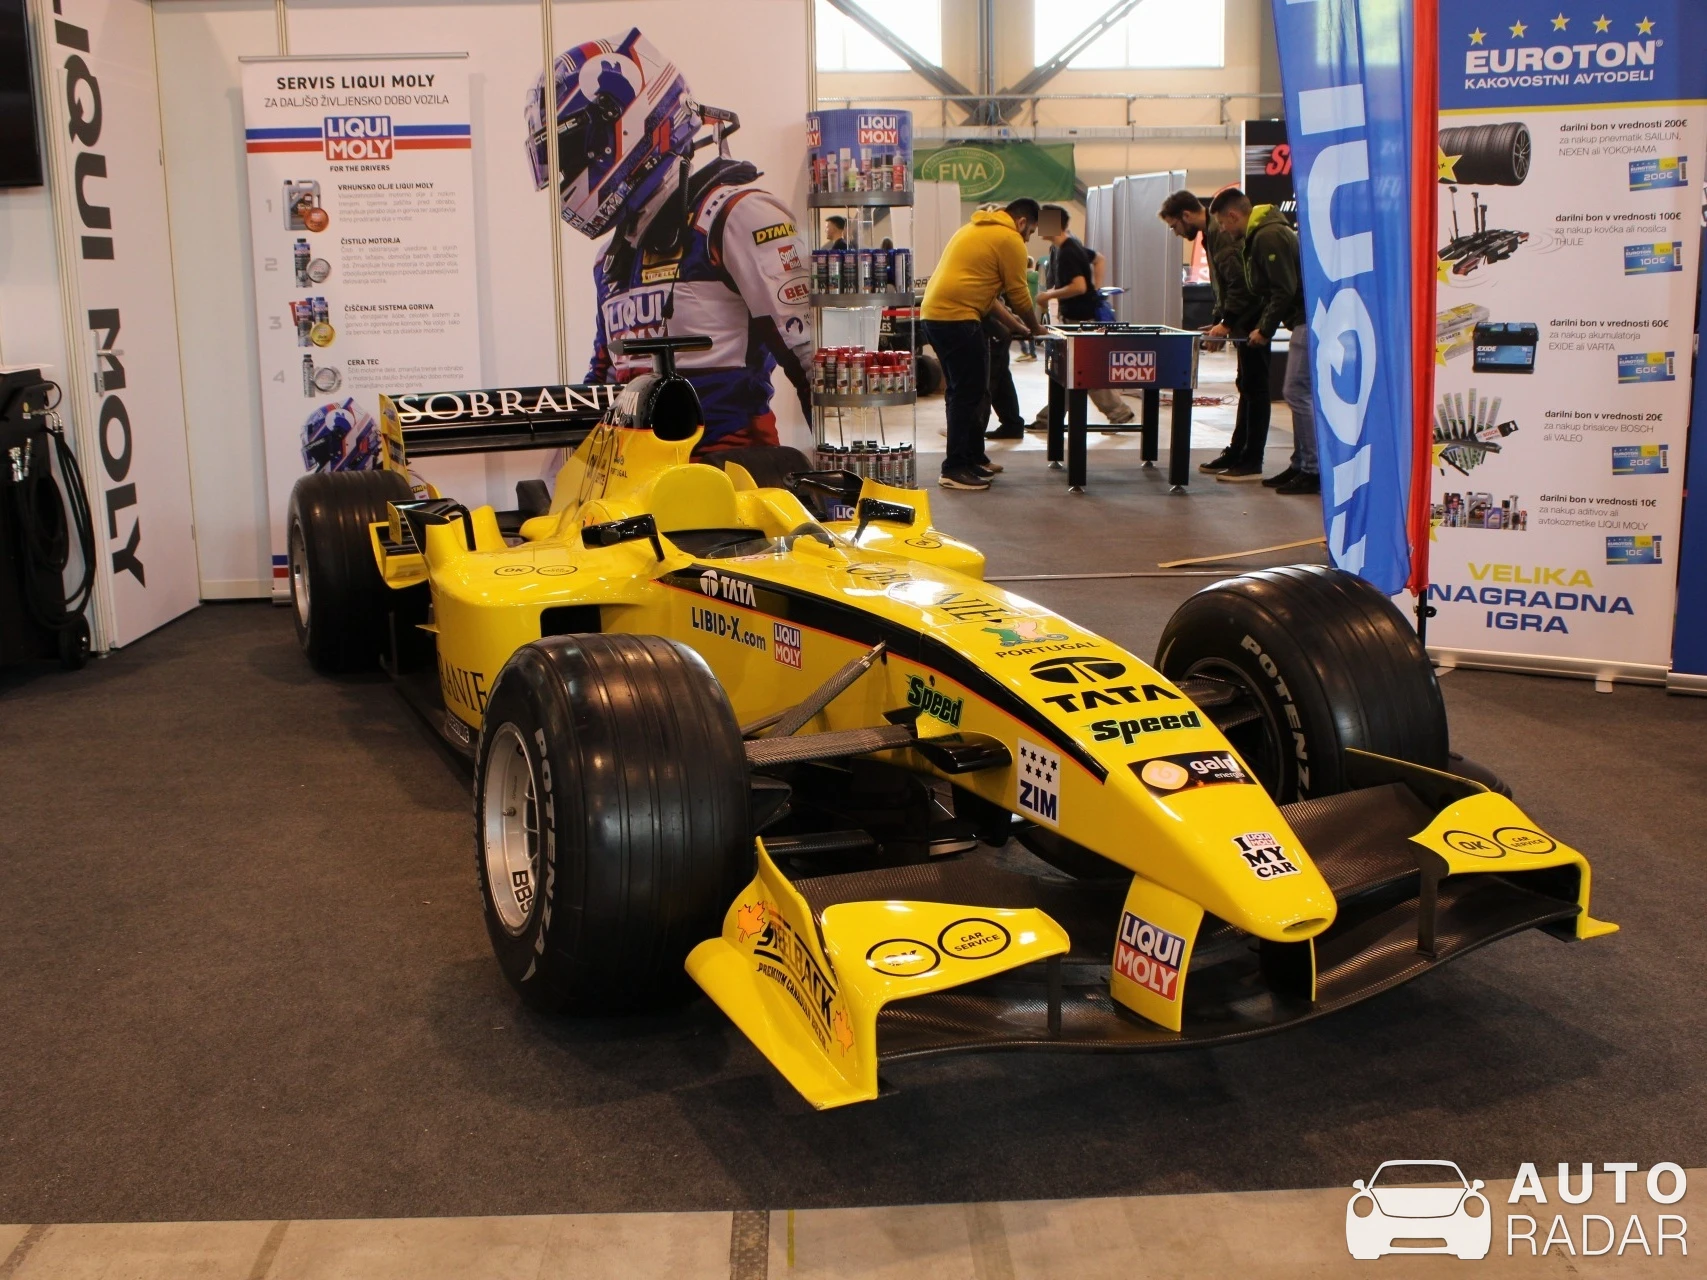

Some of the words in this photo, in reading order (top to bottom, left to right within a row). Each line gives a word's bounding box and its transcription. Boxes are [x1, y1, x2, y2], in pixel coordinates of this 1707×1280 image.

[1465, 40, 1656, 74] EUROTON
[277, 76, 335, 90] SERVIS
[341, 75, 385, 89] LIQUI
[392, 74, 435, 87] MOLY
[1465, 74, 1570, 89] KAKOVOSTNI
[1573, 69, 1654, 85] AVTODELI
[264, 97, 278, 107] ZA
[280, 94, 318, 107] DALJŠO
[321, 94, 382, 107] ŽIVLJENSKO
[384, 95, 411, 105] DOBO
[414, 94, 449, 105] VOZILA
[327, 117, 389, 139] LIQUI
[860, 116, 897, 130] LIQUI
[1560, 123, 1588, 132] darilni
[1590, 122, 1608, 131] bon
[1618, 120, 1662, 129] vrednosti
[1664, 119, 1688, 128] 200€
[860, 130, 897, 144] MOLY
[1559, 136, 1569, 144] za
[1571, 134, 1597, 144] nakup
[1599, 133, 1643, 144] pnevmatik
[328, 139, 390, 160] MOLY
[1559, 147, 1589, 156] NEXEN
[1591, 147, 1600, 156] ali
[1602, 145, 1657, 155] YOKOHAMA
[938, 162, 988, 180] FIVA
[266, 201, 272, 213] 1
[1556, 214, 1583, 222] darilni
[1585, 213, 1603, 221] bon
[1613, 212, 1656, 221] vrednosti
[1659, 212, 1681, 220] 100€
[755, 226, 787, 243] DTM
[1567, 225, 1592, 235] nakup
[1594, 224, 1624, 234] kovčka
[1626, 224, 1635, 233] ali
[1637, 223, 1667, 232] nosilca
[340, 237, 367, 245] ČISTILO
[1555, 238, 1583, 246] THULE
[264, 258, 278, 271] 2
[344, 304, 377, 312] ČIŠČENJE
[608, 292, 663, 332] LIQUI
[269, 316, 282, 330] 3
[1550, 319, 1577, 327] darilni
[1579, 319, 1597, 327] bon
[1607, 319, 1650, 327] vrednosti
[1651, 319, 1669, 328] 60€
[1561, 330, 1586, 340] nakup
[1588, 331, 1641, 341] akumulatorja
[1586, 343, 1615, 351] VARTA
[1111, 352, 1154, 367] LIQUI
[273, 371, 285, 383] 4
[1111, 367, 1155, 381] MOLY
[398, 383, 629, 423] SOBRANI
[1545, 410, 1572, 418] darilni
[1574, 411, 1592, 419] bon
[1601, 412, 1643, 421] vrednosti
[1646, 413, 1663, 421] 20€
[1556, 422, 1581, 432] nakup
[1582, 423, 1619, 432] brisalcev
[1620, 424, 1654, 433] BOSCH
[1543, 433, 1552, 441] ali
[1554, 434, 1583, 442] VALEO
[88, 308, 146, 588] MOLY
[1540, 494, 1567, 502] darilni
[1569, 495, 1587, 503] bon
[1596, 496, 1638, 506] vrednosti
[1640, 499, 1657, 507] 10€
[1550, 506, 1576, 515] nakup
[1577, 507, 1608, 516] aditivov
[1609, 509, 1619, 517] ali
[1538, 518, 1596, 528] avtokozmetike
[1598, 520, 1621, 529] LIQUI
[1623, 521, 1648, 531] MOLY
[1468, 562, 1594, 588] VELIKA
[720, 575, 757, 608] TATA
[1427, 583, 1634, 615] NAGRADNA
[691, 606, 767, 651] LIBID-X.com
[1486, 611, 1569, 634] IGRA
[774, 623, 800, 648] LIQUI
[775, 643, 801, 667] MOLY
[995, 640, 1101, 659] PORTUGAL
[908, 676, 963, 727] Speed
[1042, 684, 1183, 713] TATA
[1090, 710, 1202, 745] Speed
[1020, 779, 1057, 821] ZIM
[1234, 836, 1252, 852] I
[1458, 840, 1491, 851] OK
[1510, 838, 1545, 849] SERVICE
[1242, 845, 1286, 868] MY
[1256, 861, 1298, 878] CAR
[954, 934, 1001, 952] SERVICE
[960, 931, 984, 943] CAR
[1121, 914, 1181, 966] LIQUI
[1117, 944, 1178, 995] MOLY
